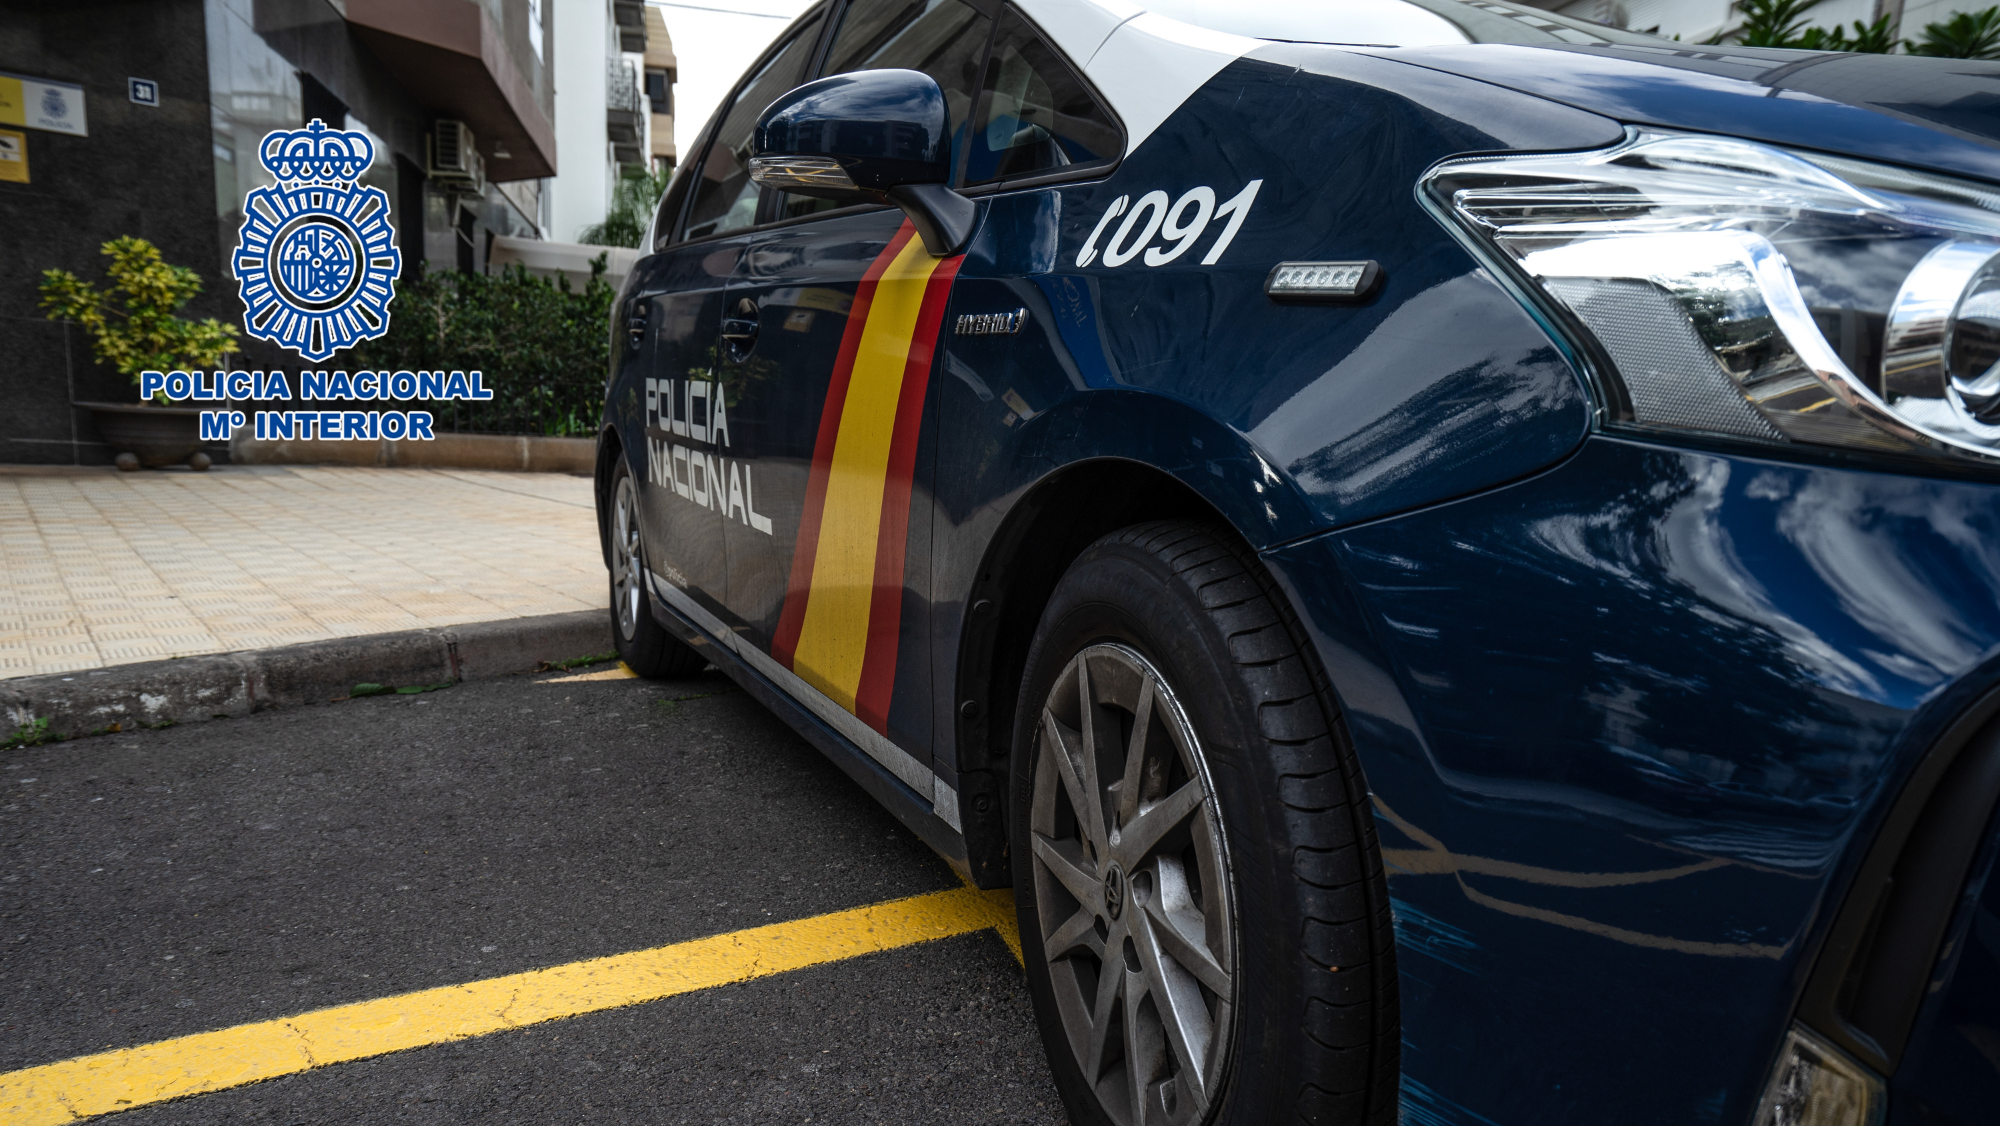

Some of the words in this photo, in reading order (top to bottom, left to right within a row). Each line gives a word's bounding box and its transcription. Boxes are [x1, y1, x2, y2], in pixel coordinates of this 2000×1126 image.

[1102, 178, 1264, 268] 091
[954, 312, 1013, 334] HYBRID
[645, 366, 730, 448] POLICÍA
[647, 436, 773, 536] NACIONAL
